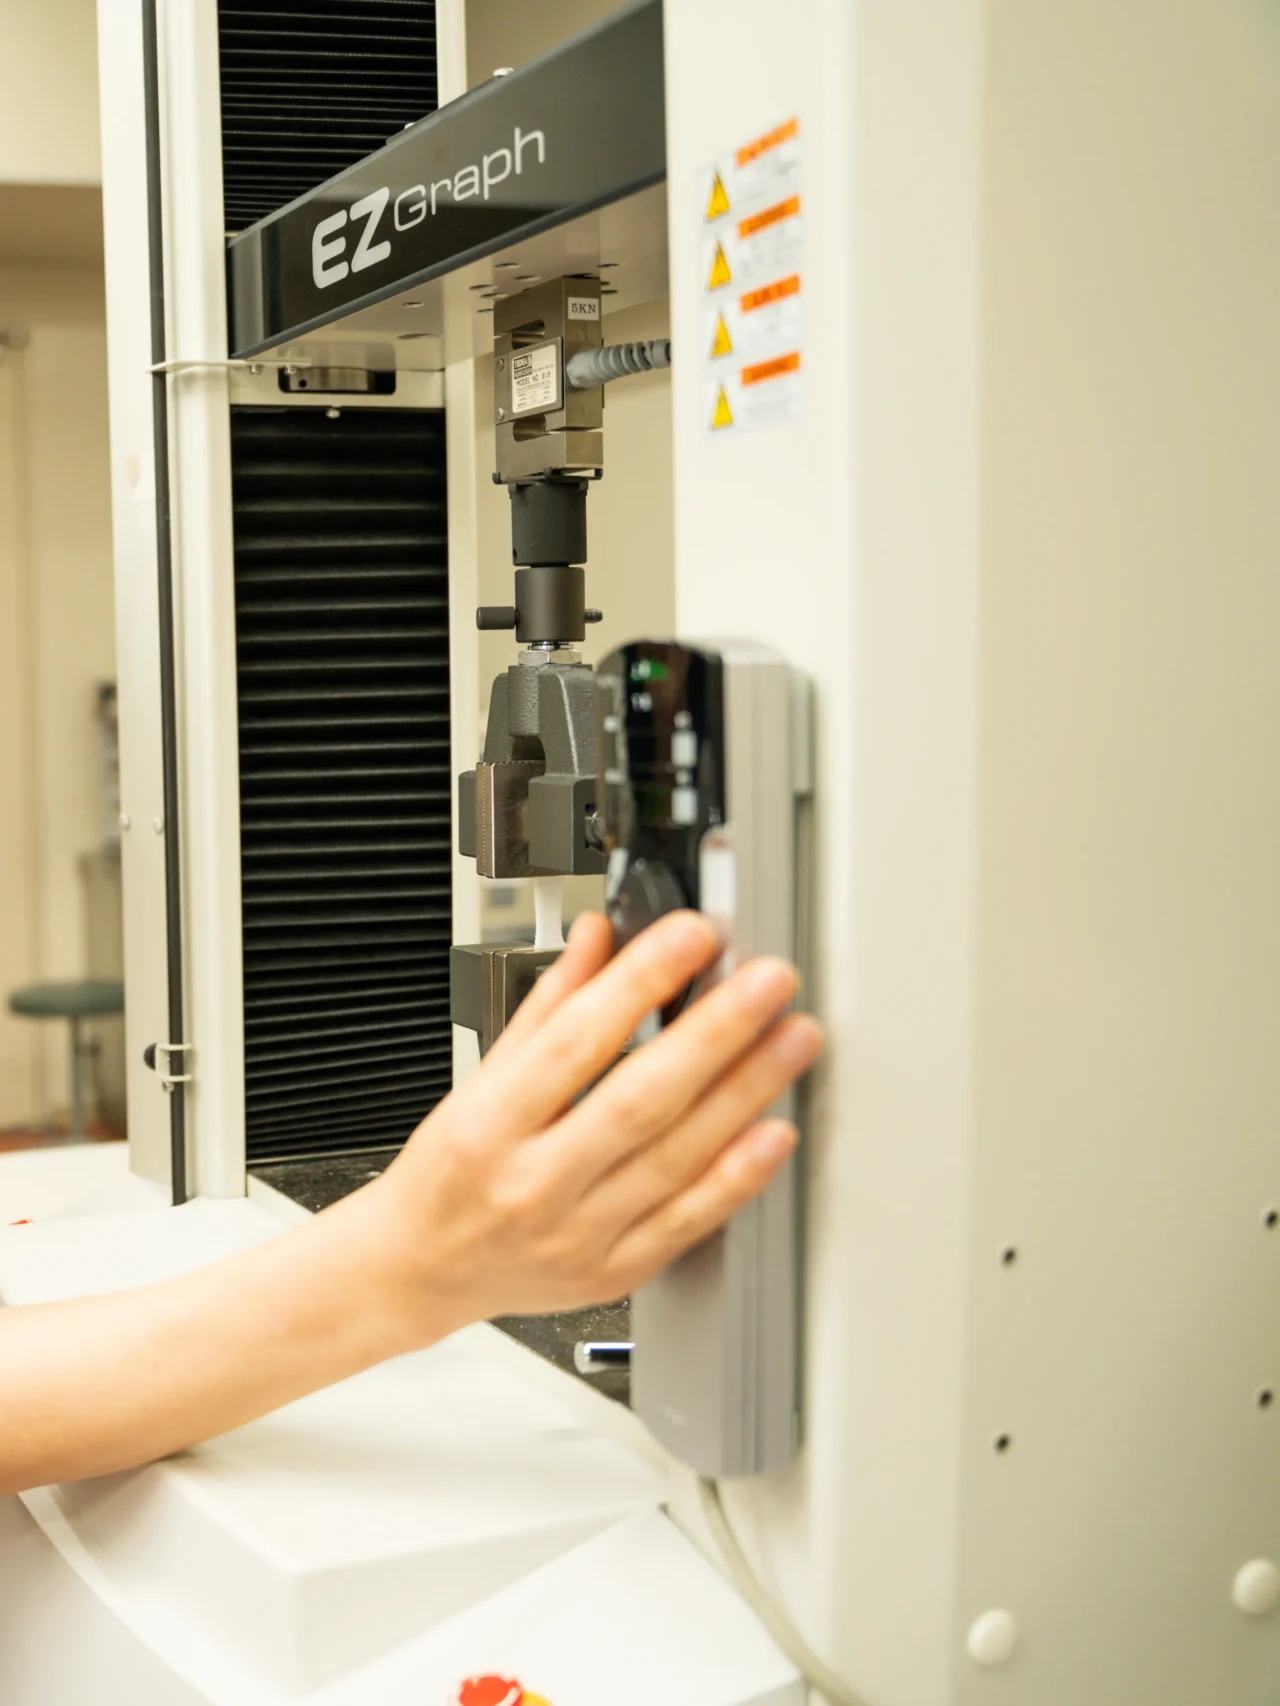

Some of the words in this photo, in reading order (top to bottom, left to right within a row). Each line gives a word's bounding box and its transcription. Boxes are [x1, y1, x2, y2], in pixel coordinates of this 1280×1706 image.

[312, 186, 391, 289] EZ
[394, 127, 545, 231] Graph
[571, 303, 596, 314] 5KN
